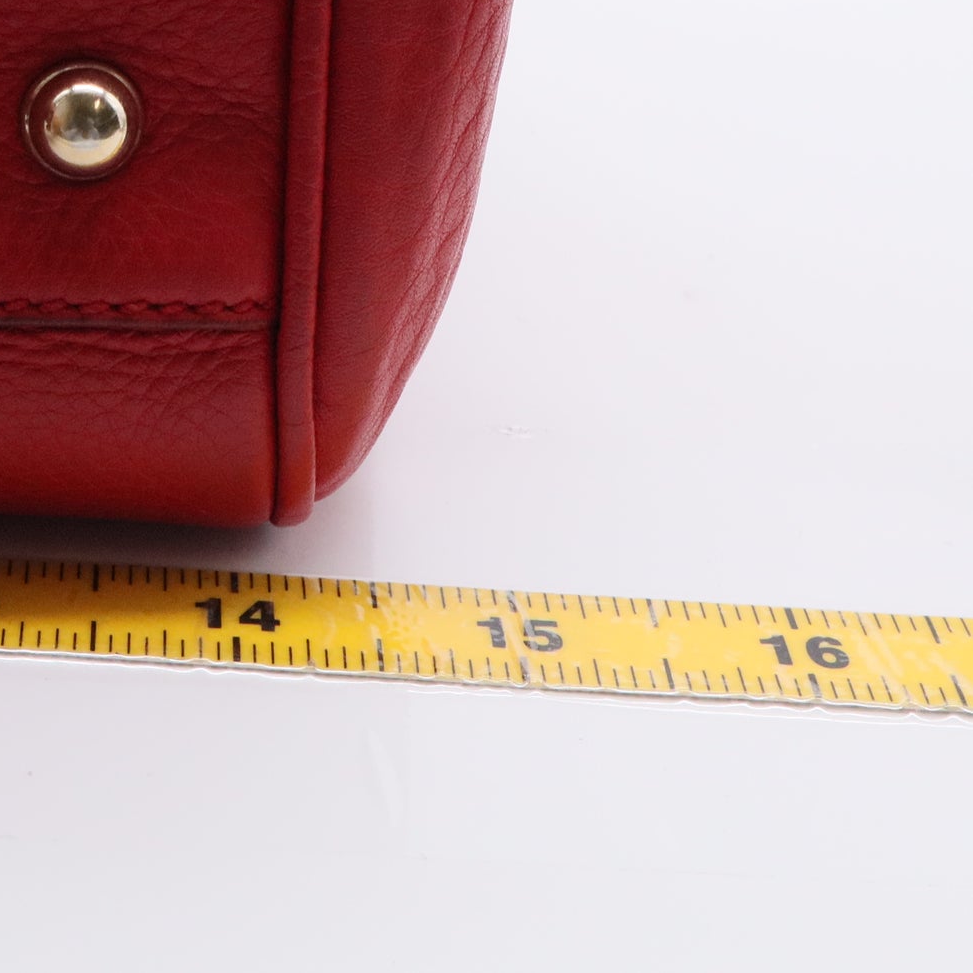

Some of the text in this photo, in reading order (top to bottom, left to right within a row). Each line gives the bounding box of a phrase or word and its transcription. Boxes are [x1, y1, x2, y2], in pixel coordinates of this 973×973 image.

[194, 597, 281, 631] 14
[476, 615, 564, 653] 15
[759, 634, 851, 669] 16
